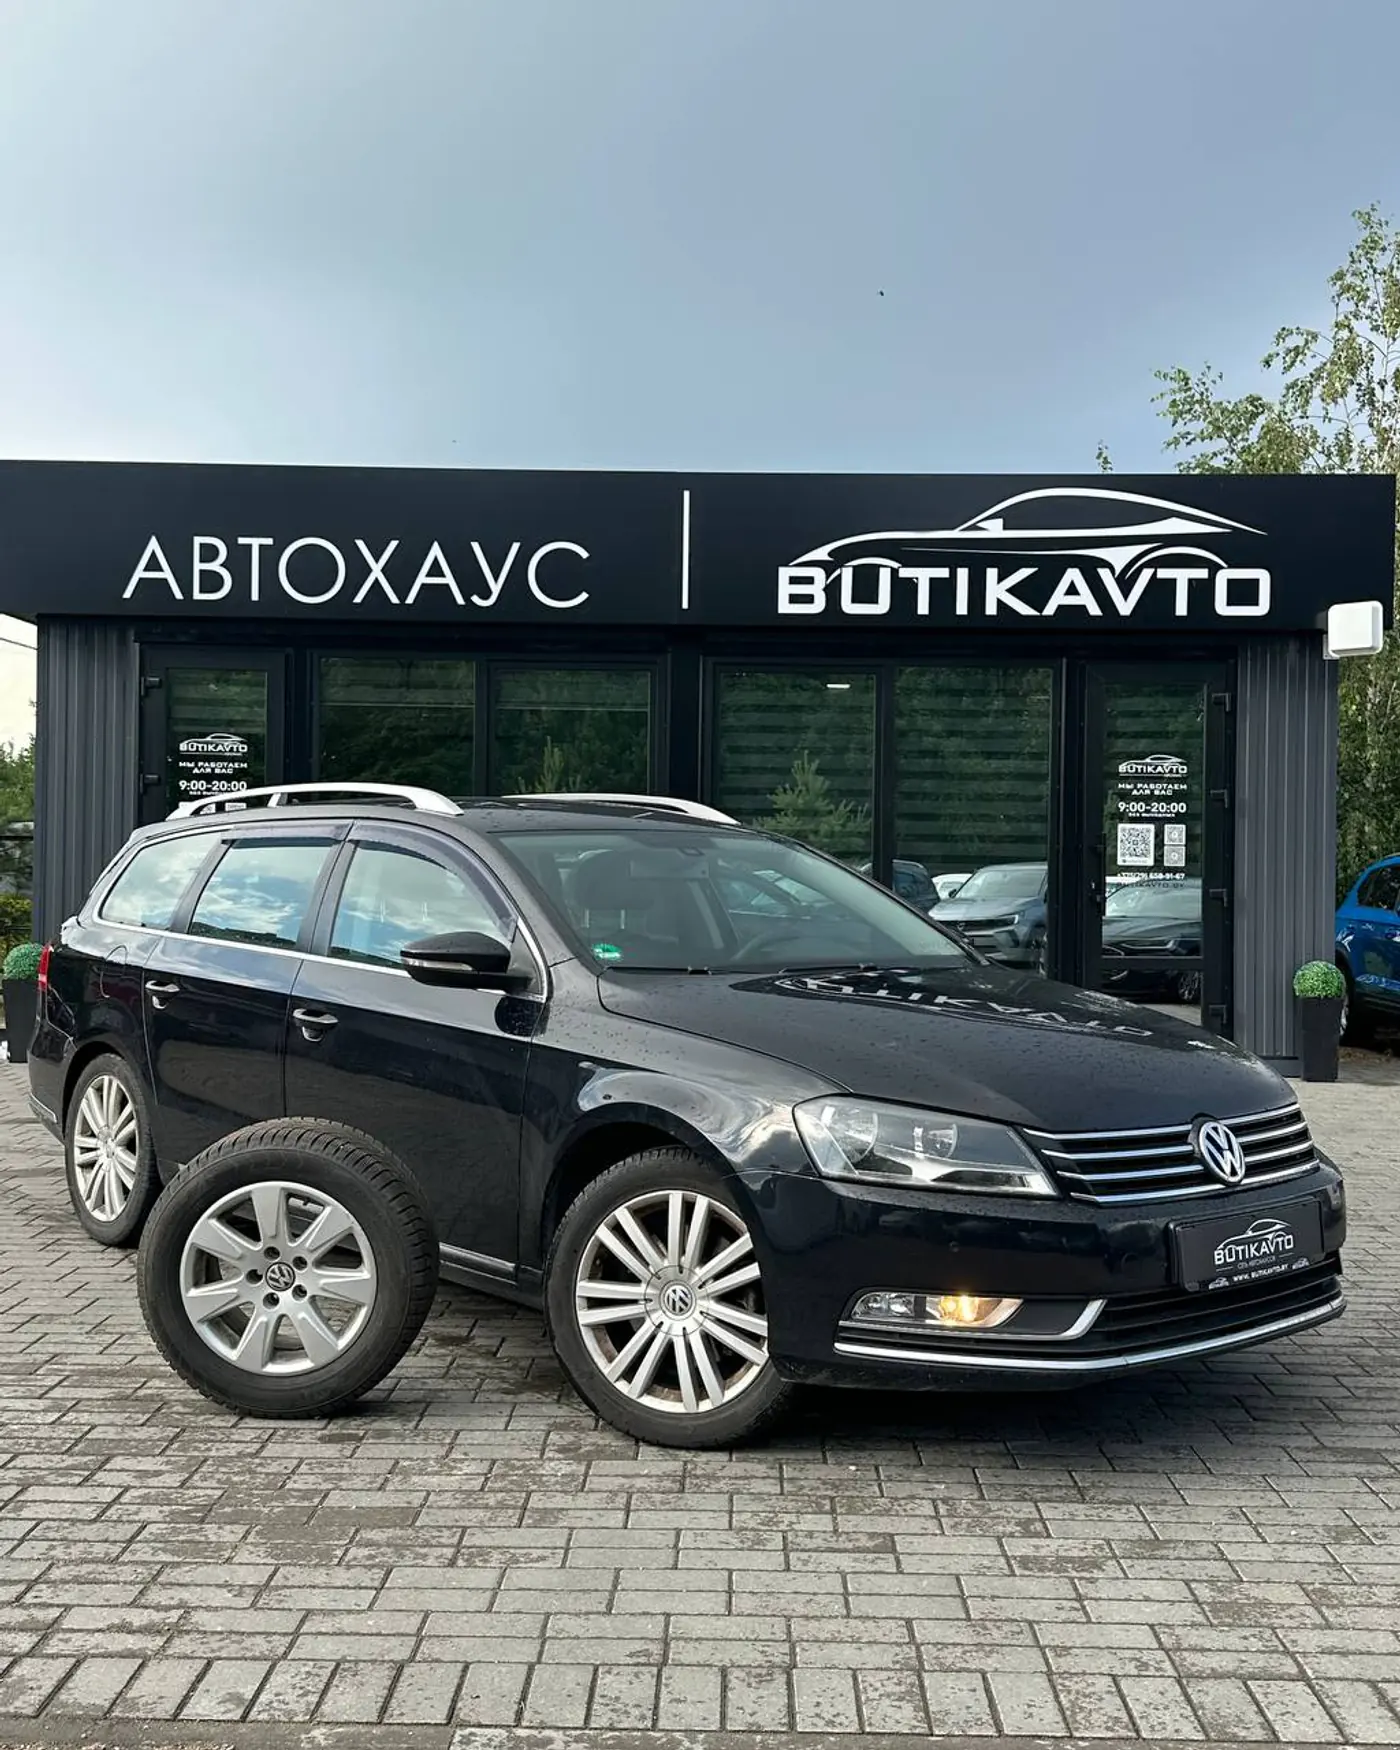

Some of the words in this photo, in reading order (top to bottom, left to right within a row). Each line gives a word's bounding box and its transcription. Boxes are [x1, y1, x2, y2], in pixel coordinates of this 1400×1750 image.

[121, 534, 591, 609] АВТОХАУС
[777, 564, 1272, 617] BUTIKAVTO
[179, 743, 248, 752] BUTIKAVTO
[1118, 765, 1188, 773] BUTIKAVTO
[179, 780, 247, 791] 9:00-20:00
[1118, 802, 1187, 812] 9:00-20:00
[1213, 1234, 1295, 1265] BUTIKAVTO
